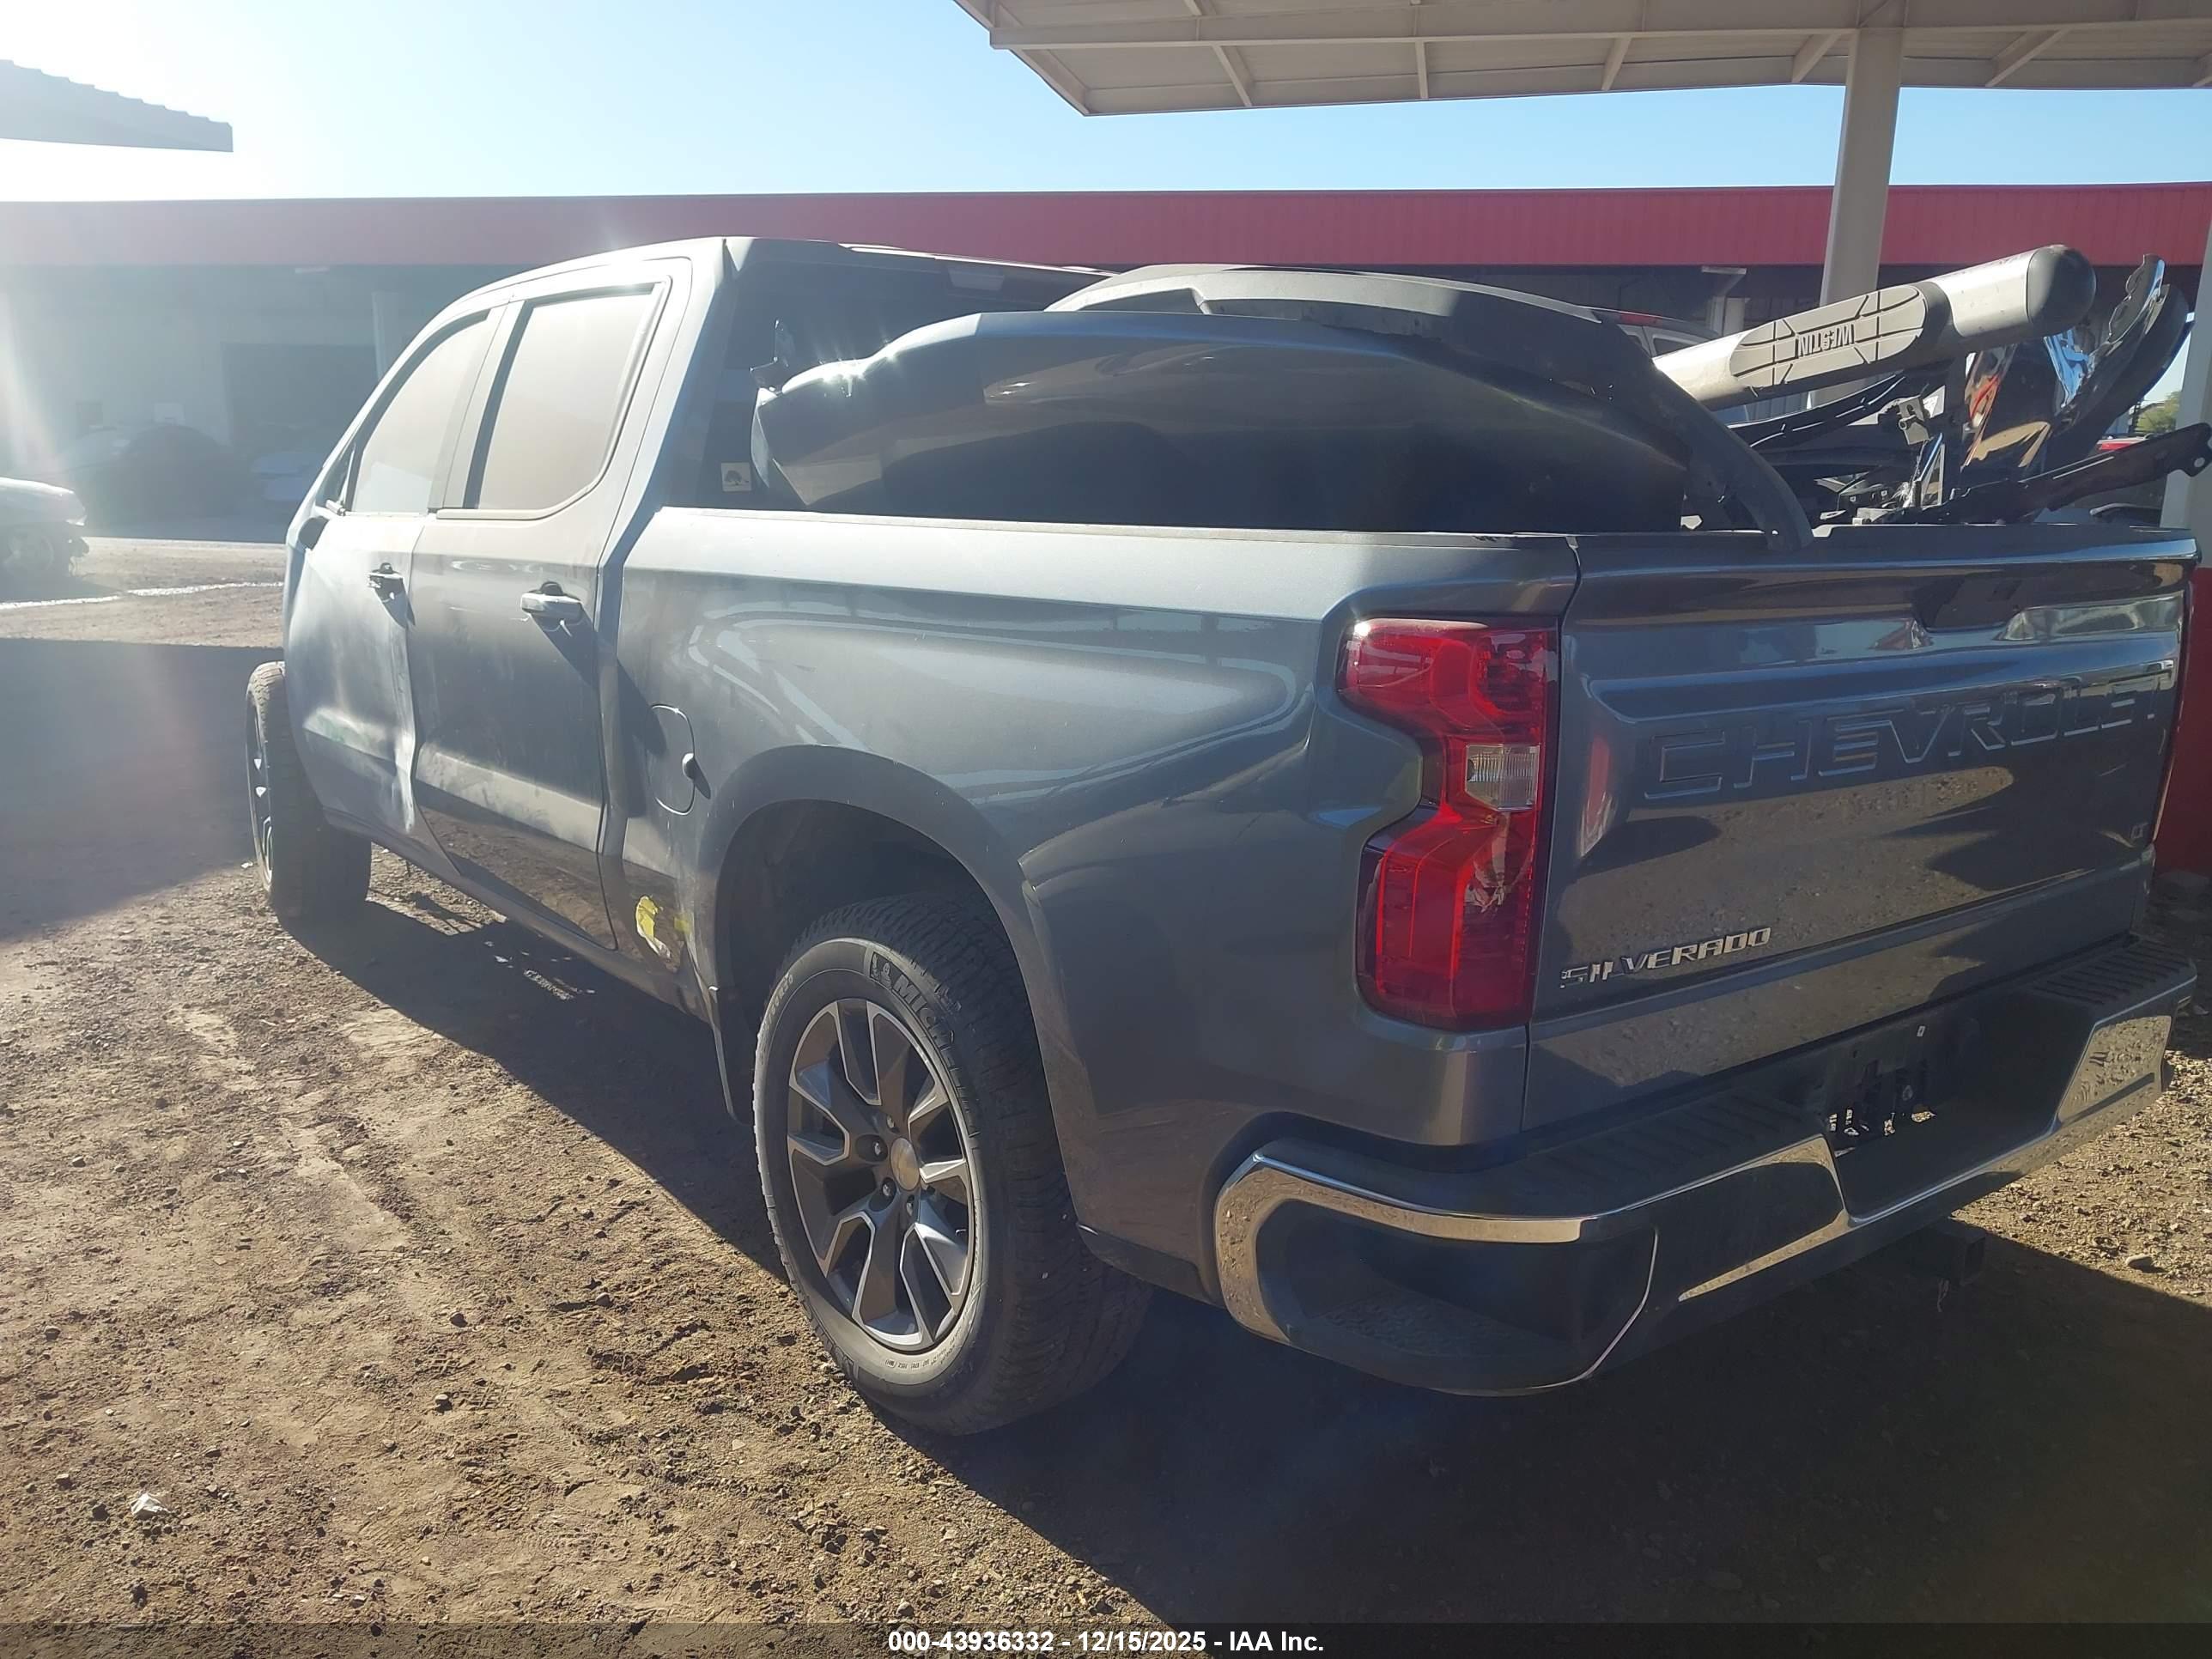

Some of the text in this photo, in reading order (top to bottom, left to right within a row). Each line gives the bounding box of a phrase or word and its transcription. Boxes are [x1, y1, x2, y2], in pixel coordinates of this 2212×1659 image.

[1797, 324, 1855, 357] WESTIN
[1644, 676, 2172, 799] CHEVROLET
[1559, 927, 1771, 988] SILVERADO
